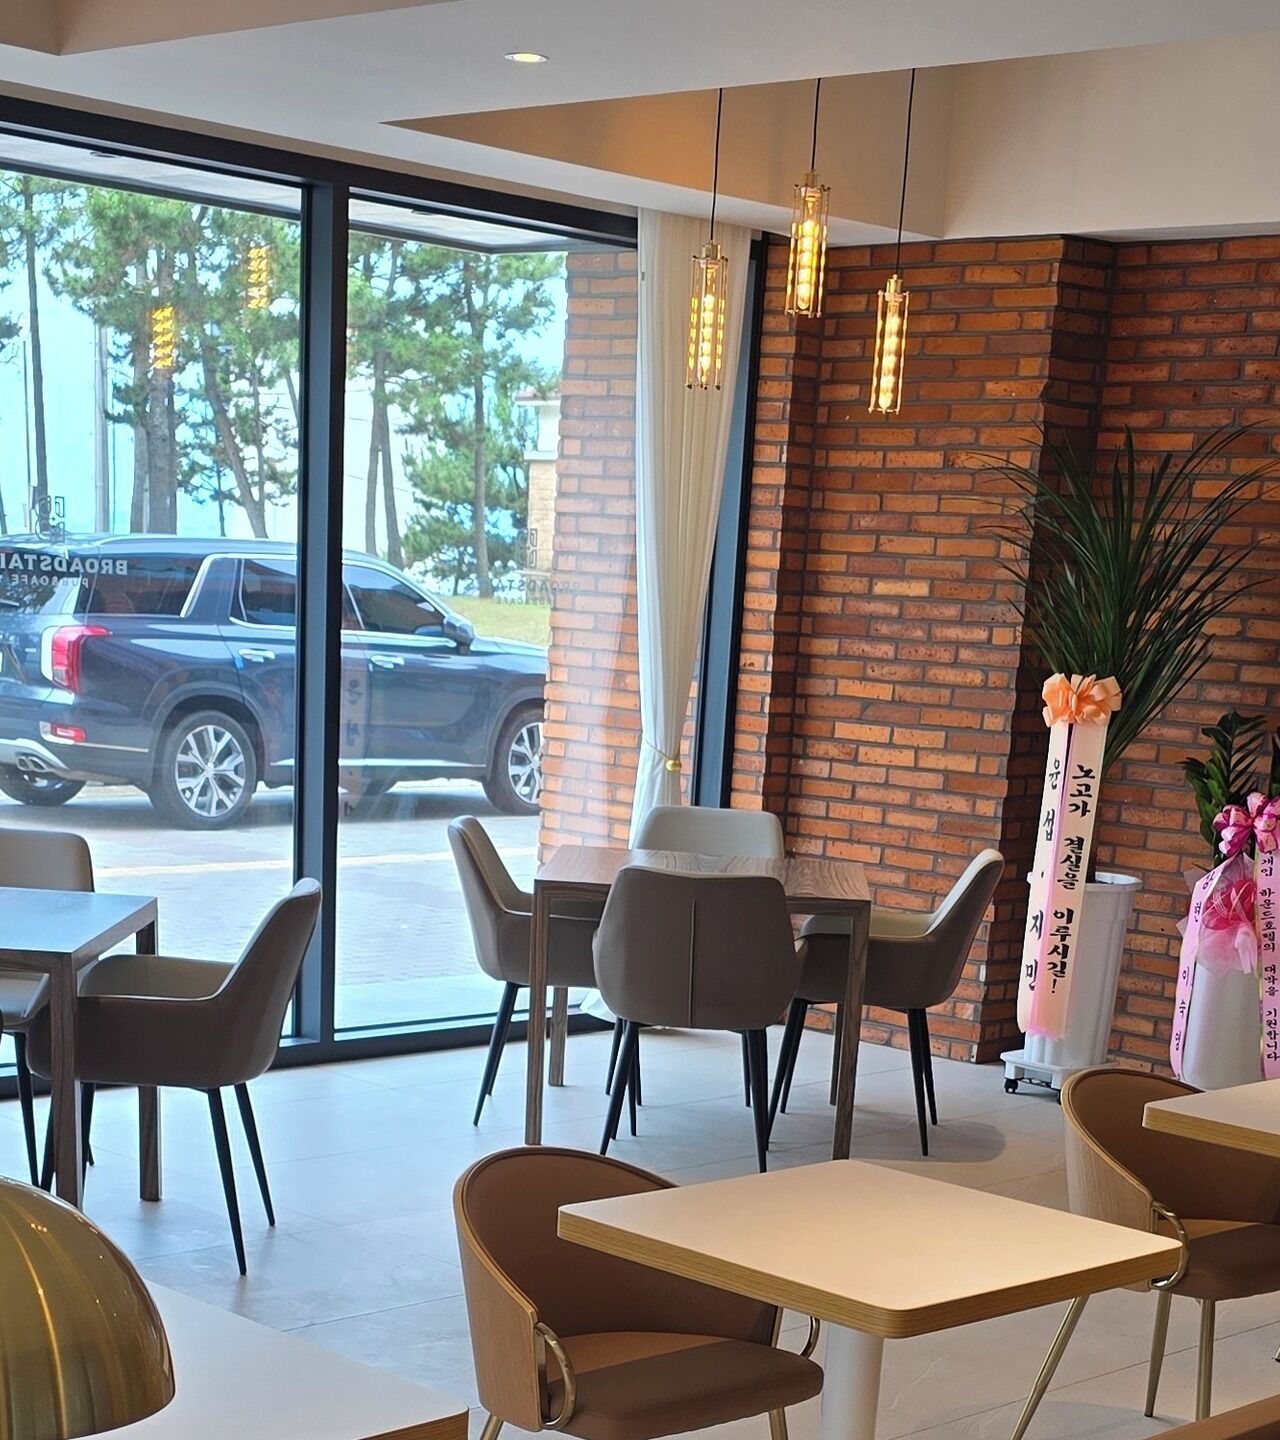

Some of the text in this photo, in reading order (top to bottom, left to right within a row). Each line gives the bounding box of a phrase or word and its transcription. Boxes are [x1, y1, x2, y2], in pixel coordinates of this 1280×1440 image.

[1047, 764, 1096, 994] 노고가 결실을 이루시길!
[1266, 1008, 1280, 1062] 기원합니다
